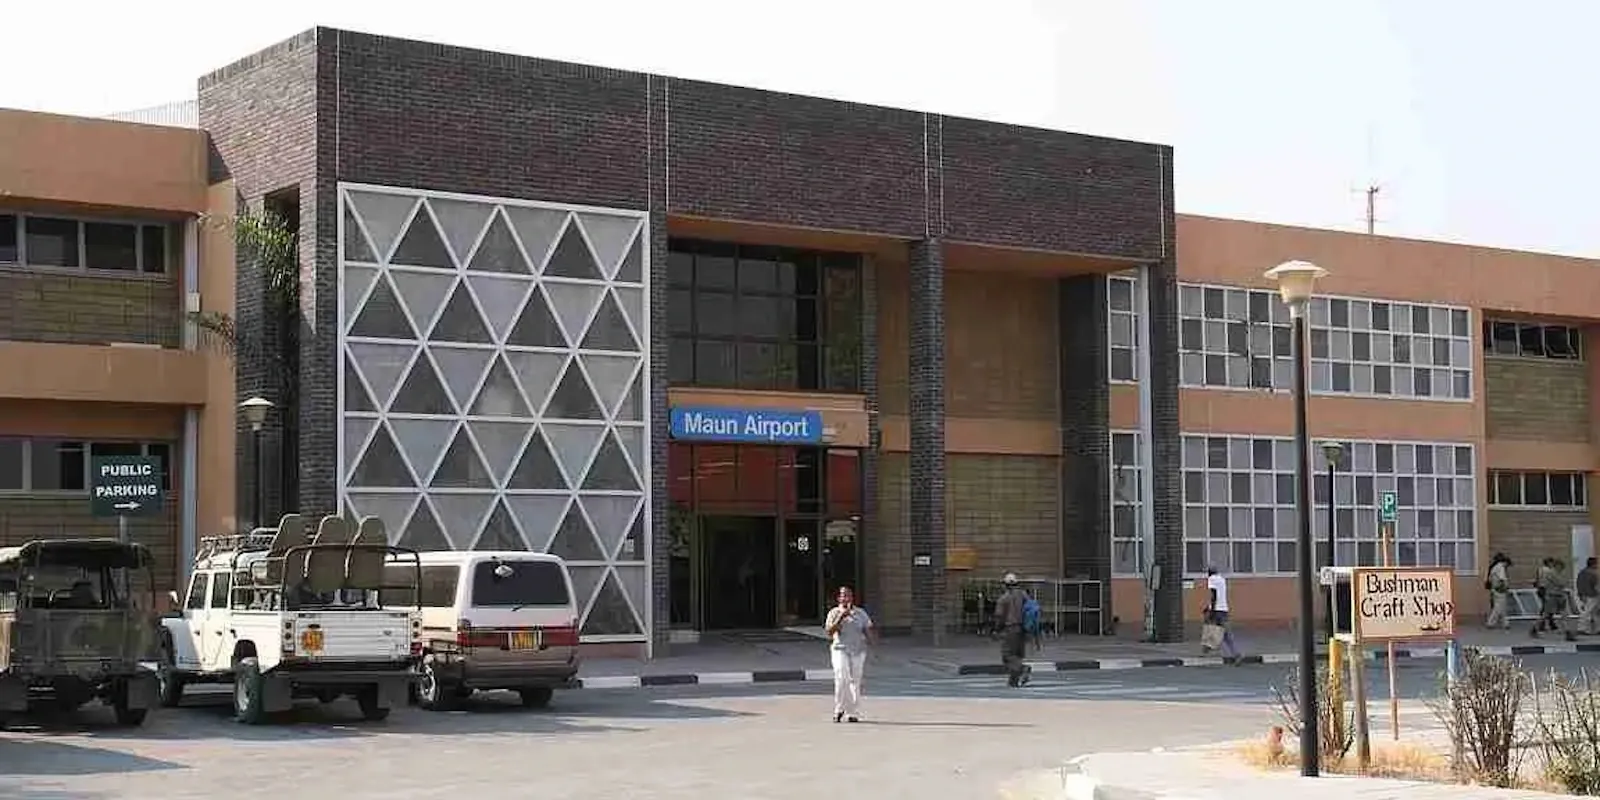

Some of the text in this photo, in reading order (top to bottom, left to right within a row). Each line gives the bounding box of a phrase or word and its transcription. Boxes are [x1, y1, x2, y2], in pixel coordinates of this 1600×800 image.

[685, 412, 809, 441] Maun Airport
[101, 464, 152, 477] PUBLIC
[95, 484, 158, 498] PARKING
[1384, 494, 1395, 510] P
[1366, 573, 1440, 594] Bushman
[1361, 595, 1454, 621] Craft Shop
